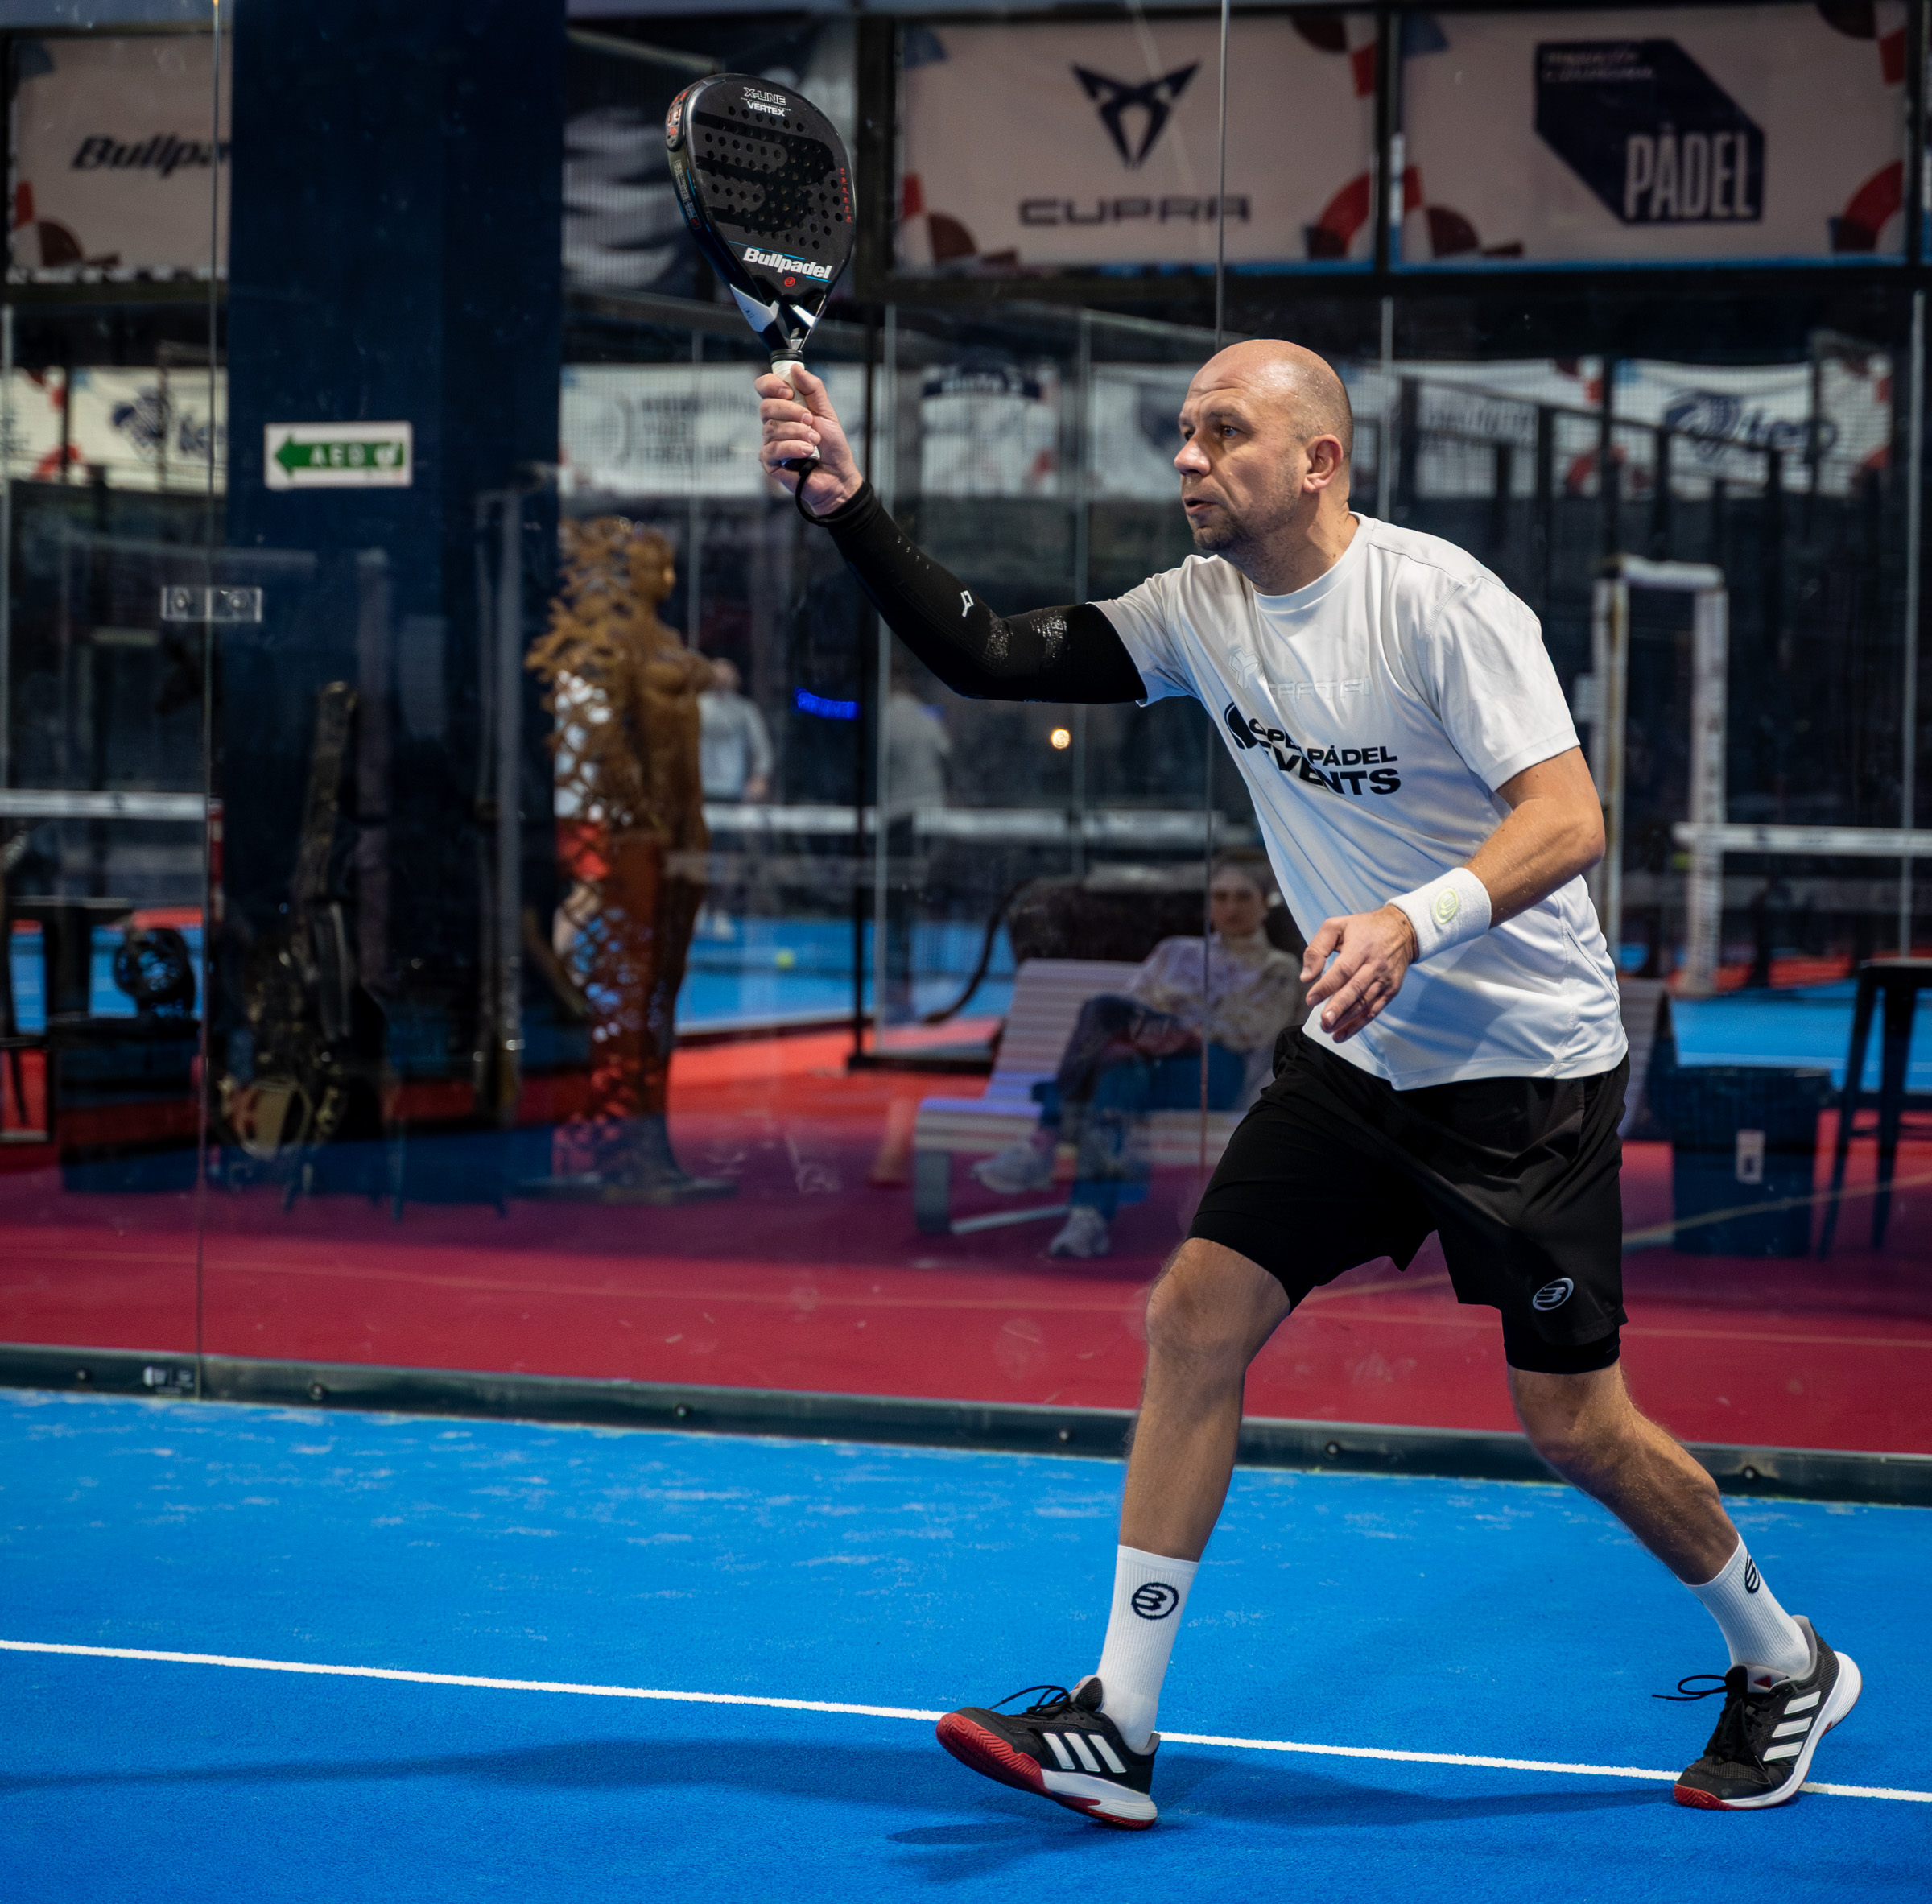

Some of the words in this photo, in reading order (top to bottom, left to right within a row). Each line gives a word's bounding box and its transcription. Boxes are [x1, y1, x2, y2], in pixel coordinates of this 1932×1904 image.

[743, 86, 786, 106] X-LINE
[747, 101, 786, 118] VERTEX
[1623, 122, 1757, 221] PÁDEL
[1018, 196, 1252, 226] CUPRA
[743, 246, 832, 279] Bullpadel
[1307, 745, 1398, 766] PÁDEL
